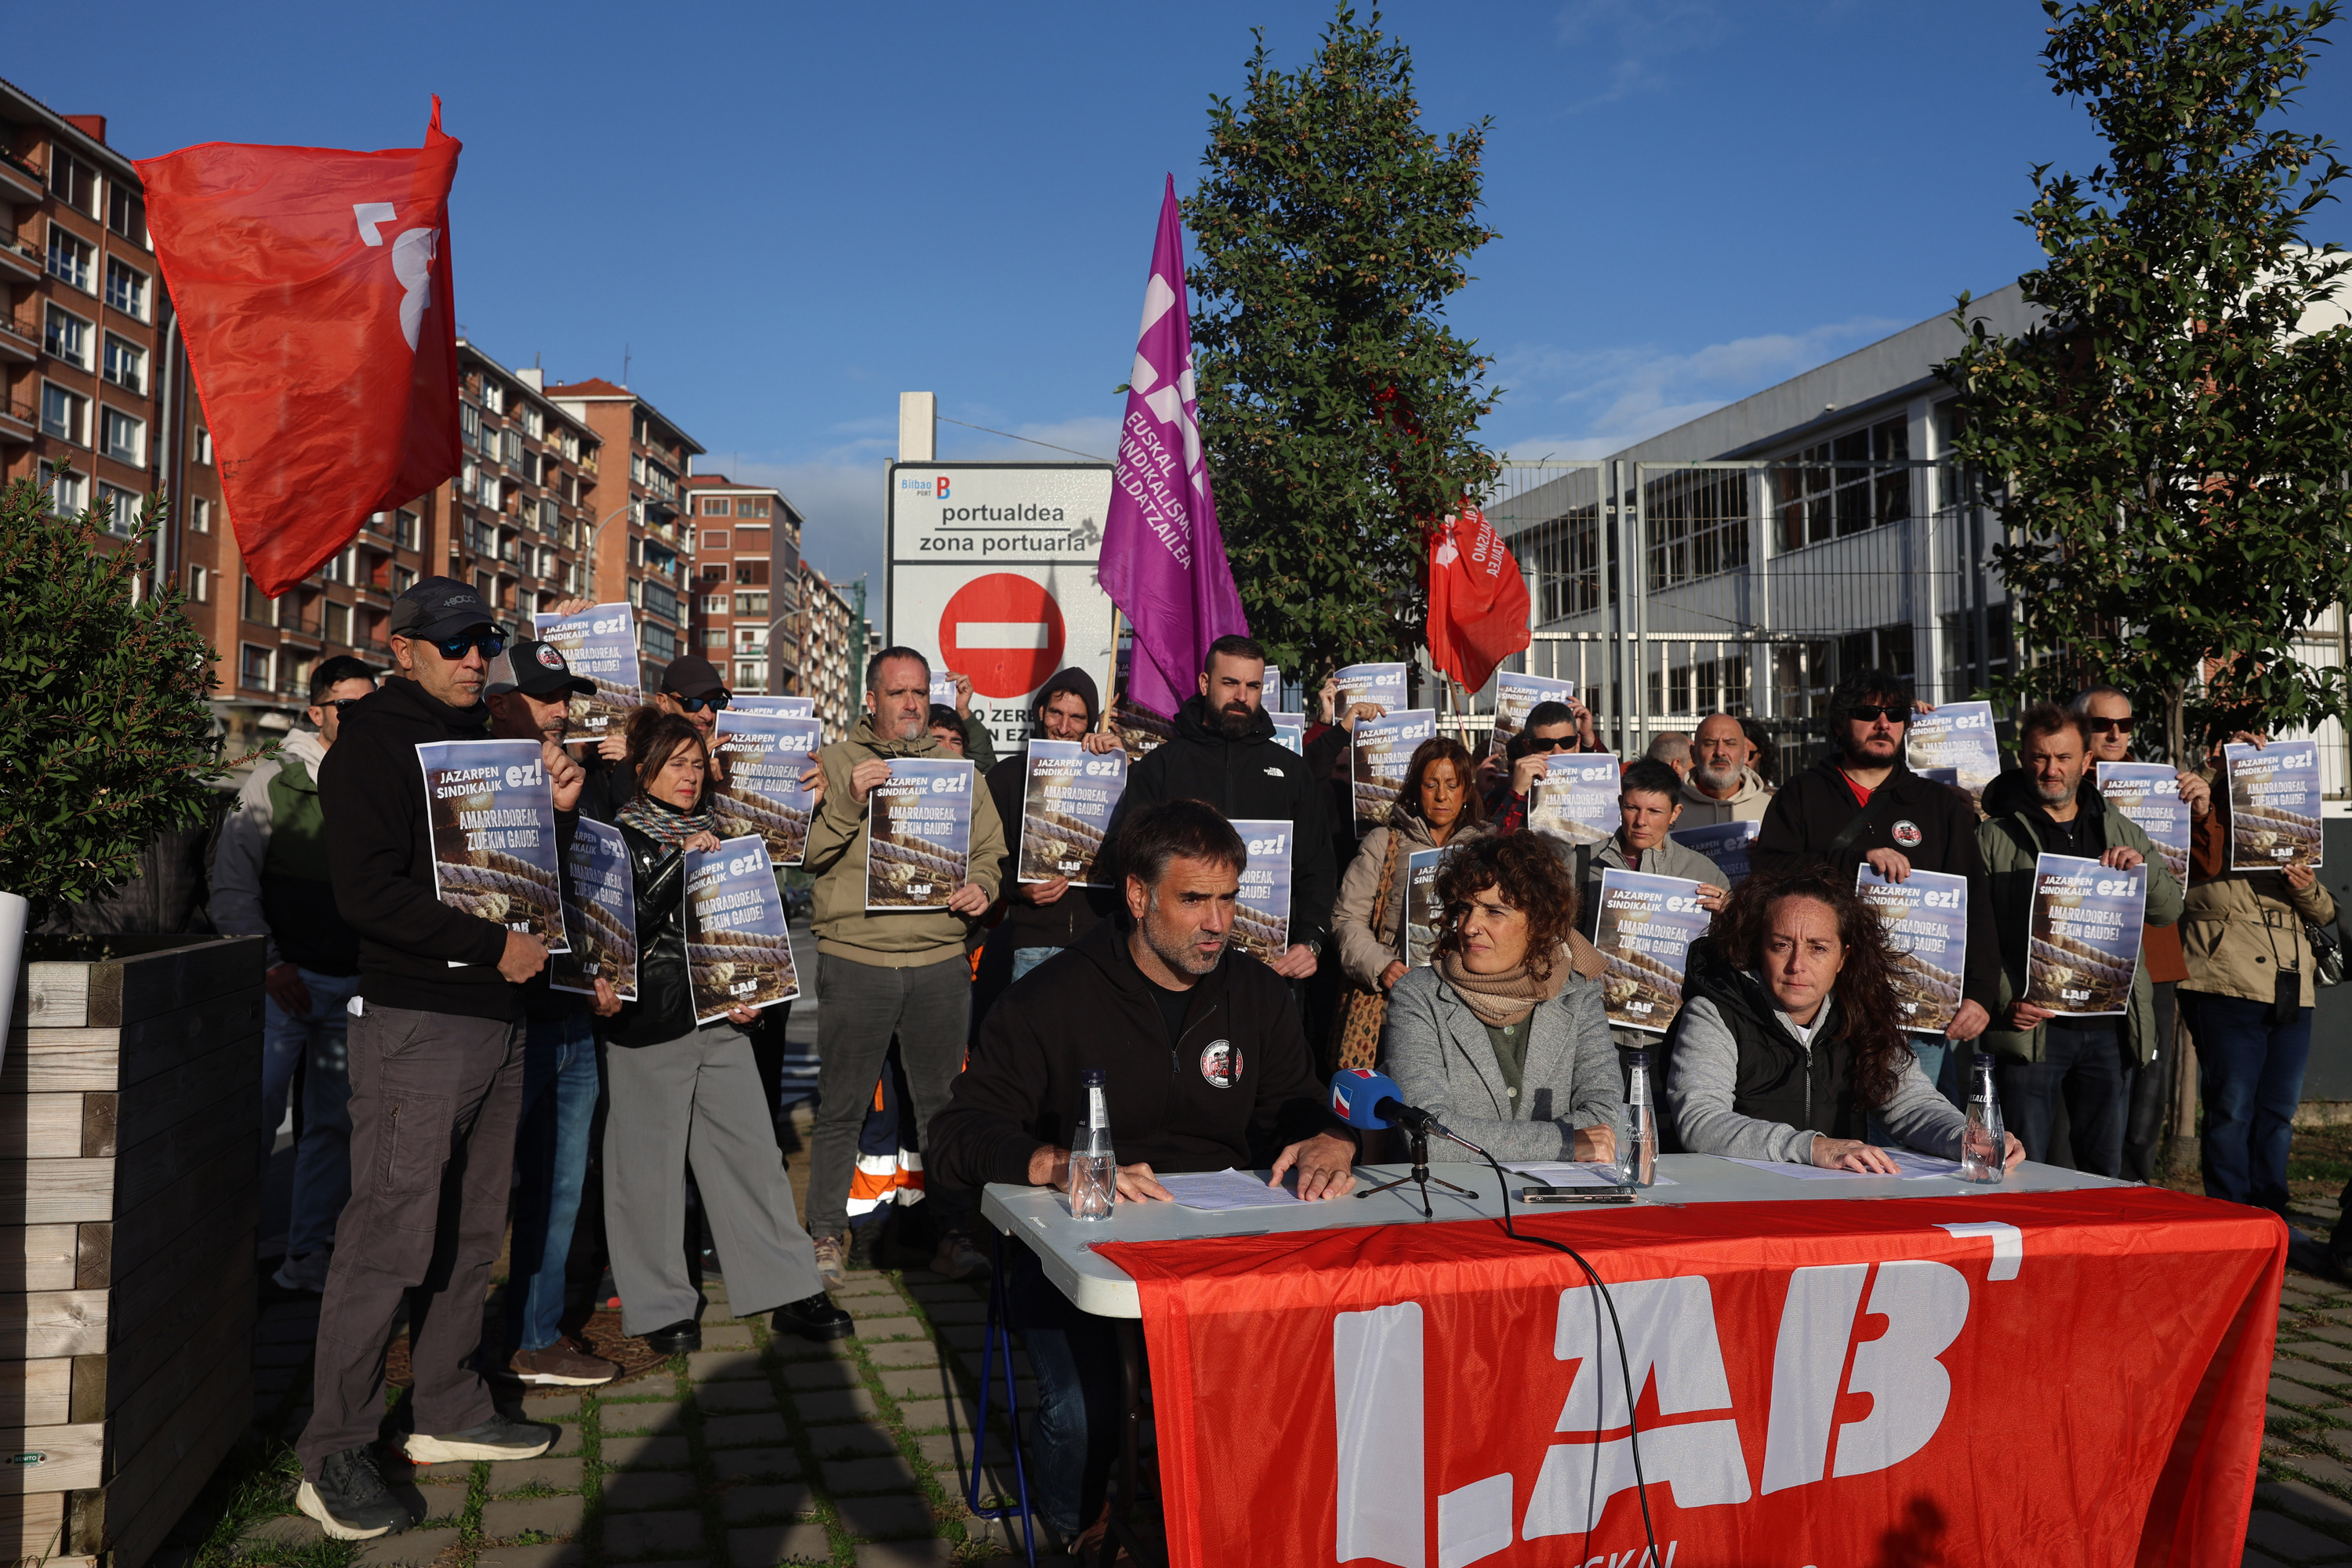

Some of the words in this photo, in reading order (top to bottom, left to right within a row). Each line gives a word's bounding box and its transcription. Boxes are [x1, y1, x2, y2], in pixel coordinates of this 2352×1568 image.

[1127, 411, 1176, 478] EUSKAL
[902, 479, 931, 489] Bilbao
[942, 503, 1064, 525] portualdea
[920, 537, 974, 551] zona
[982, 534, 1086, 555] portuaria
[444, 595, 476, 606] +8000
[546, 621, 588, 633] JAZARPEN
[593, 614, 626, 634] ez!
[543, 630, 590, 642] SINDIKALIK
[568, 662, 590, 673] UEKIN
[592, 660, 619, 672] GAUDE!
[1337, 681, 1373, 691] SINDIKALIK
[1376, 672, 1401, 685] ez!
[1261, 680, 1275, 695] z!
[1501, 693, 1537, 702] SINDIKALIK
[1541, 691, 1566, 702] ez!
[1913, 717, 1951, 728] JAZARPEN
[1956, 712, 1986, 729] ez!
[1359, 727, 1398, 739] JAZARPEN
[1402, 720, 1429, 739] ez!
[1911, 725, 1954, 735] SINDIKALIK
[721, 743, 775, 752] SINDIKALIK
[779, 731, 814, 751] ez!
[1357, 735, 1399, 747] SINDIKALIK
[2238, 757, 2278, 768] JAZARPEN
[2282, 750, 2312, 769] ez!
[441, 767, 499, 784] JAZARPEN
[506, 759, 542, 788] ez!
[730, 761, 800, 780] AMARRADOREAK,
[1086, 759, 1121, 777] ez!
[1371, 766, 1397, 777] ZUEKIN
[1581, 764, 1612, 781] ez!
[2234, 764, 2280, 776] SINDIKALIK
[731, 776, 762, 790] ZUEKIN
[764, 779, 796, 793] GAUDE!
[931, 773, 967, 793] ez!
[1534, 777, 1578, 786] SINDIKALIK
[2107, 780, 2151, 789] JAZARPEN
[2154, 780, 2180, 794] ez
[2247, 781, 2308, 794] AMARRADOREAK,
[437, 780, 502, 799] SINDIKALIK
[877, 786, 927, 797] SINDIKALIK
[1044, 786, 1109, 804] AMARRADOREAK,
[2103, 789, 2151, 797] SINDIKALIK
[1545, 794, 1606, 806] AMARRADOREAK,
[2251, 795, 2278, 807] ZUEKIN
[2281, 793, 2306, 804] GAUDE!
[888, 807, 956, 822] AMARRADOREAK,
[1046, 800, 1075, 814] ZUEKIN
[1076, 803, 1104, 816] GAUDE!
[1578, 807, 1604, 818] GAUDE!
[459, 808, 540, 830] AMARRADOREAK,
[2145, 820, 2172, 832] GAUDE!
[891, 821, 921, 835] ZUEKIN
[924, 822, 953, 835] GAUDE!
[466, 830, 506, 851] ZUEKIN
[507, 829, 539, 849] GAUDE!
[574, 831, 597, 843] ARPEN
[1248, 834, 1285, 855] ez!
[600, 837, 626, 859] ez!
[730, 848, 764, 877] ez!
[569, 862, 624, 892] AMARRADOREAK,
[689, 862, 724, 883] JAZARPEN
[687, 872, 727, 895] SINDIKALIK
[2045, 877, 2093, 886] JAZARPEN
[2096, 877, 2138, 897] ez!
[574, 880, 600, 902] ZUEKIN
[600, 888, 623, 907] GAUDE!
[1239, 886, 1271, 899] GAUDE!
[1613, 891, 1662, 902] JAZARPEN
[1869, 886, 1920, 897] JAZARPEN
[2040, 886, 2093, 896] SINDIKALIK
[695, 888, 764, 917] AMARRADOREAK,
[1607, 900, 1662, 912] SINDIKALIK
[1925, 889, 1960, 909] ez!
[699, 912, 731, 933] ZUEKIN
[732, 906, 764, 926] GAUDE!
[2049, 906, 2124, 927] AMARRADOREAK,
[1617, 920, 1689, 943] AMARRADOREAK,
[2050, 921, 2082, 938] ZUEKIN
[2084, 925, 2119, 941] GAUDE!
[1618, 935, 1650, 952] ZUEKIN
[1652, 940, 1684, 956] GAUDE!
[1915, 937, 1946, 953] GAUDE!
